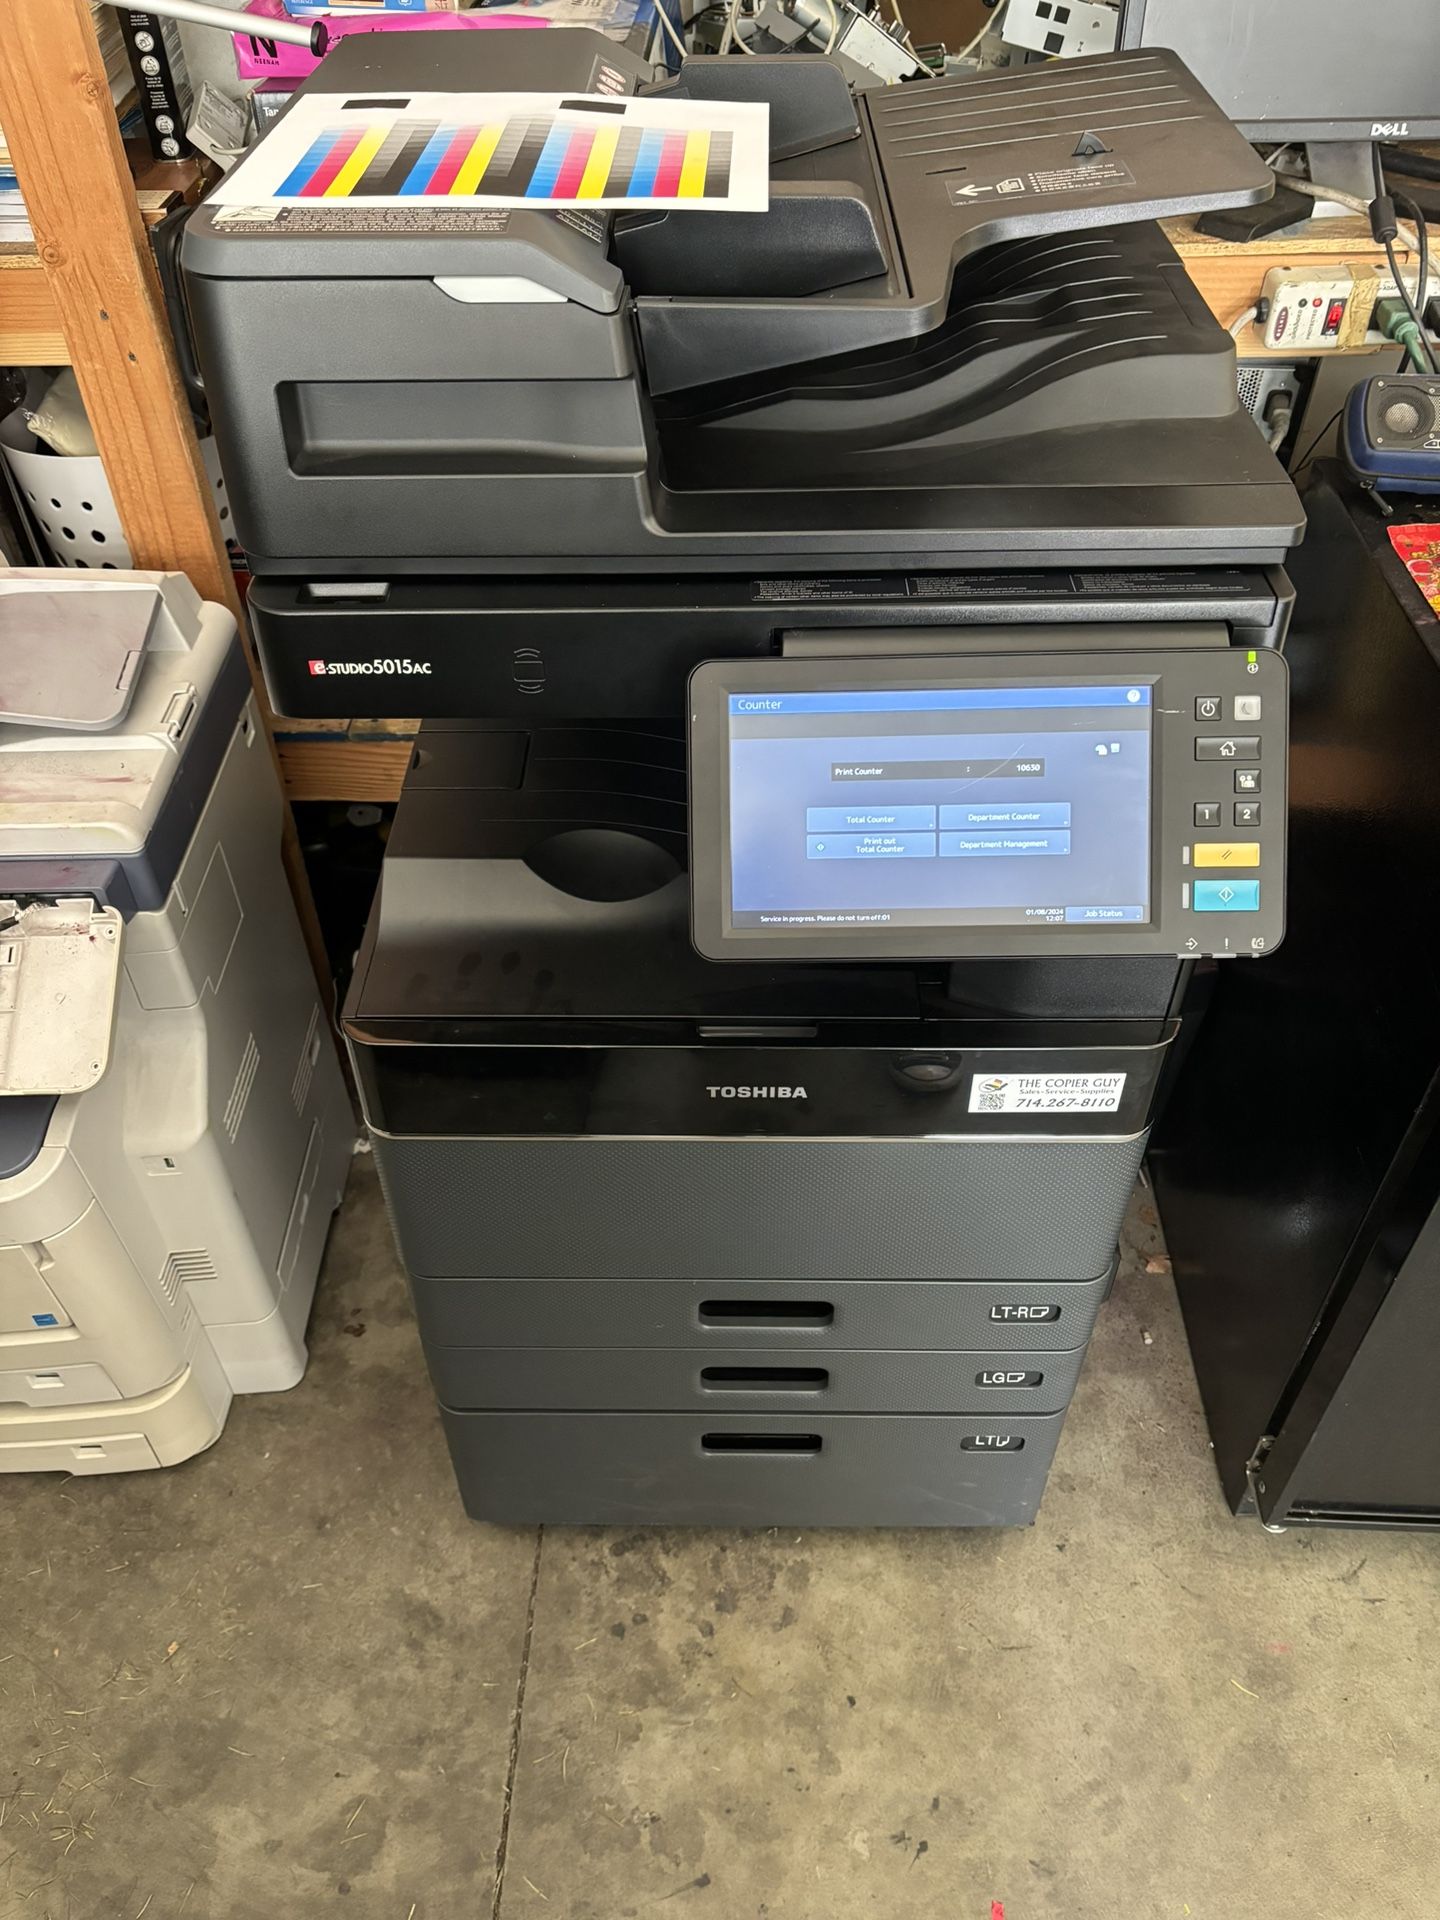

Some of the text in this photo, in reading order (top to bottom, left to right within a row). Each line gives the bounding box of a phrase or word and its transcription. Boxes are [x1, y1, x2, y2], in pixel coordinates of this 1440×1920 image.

[254, 58, 280, 66] NEENAH
[1370, 122, 1409, 137] DELL
[737, 699, 783, 711] Counter
[834, 767, 853, 776] Print
[854, 767, 884, 776] Counter
[846, 815, 896, 824] Total Counter
[967, 812, 1041, 823] Department Counter
[1204, 809, 1210, 820] 1
[1243, 808, 1251, 820] 2
[863, 837, 897, 845] Print out
[960, 839, 1048, 850] Department Management
[855, 845, 905, 854] Total Counter
[760, 915, 781, 923] Service
[817, 914, 836, 922] Please
[1084, 909, 1124, 918] Job Status
[1018, 1077, 1121, 1088] THE COPIER GUY
[706, 1086, 808, 1098] TOSHIBA
[1016, 1097, 1116, 1108] 714.267-8110
[991, 1306, 1029, 1319] LT-R
[982, 1372, 1006, 1384] LG
